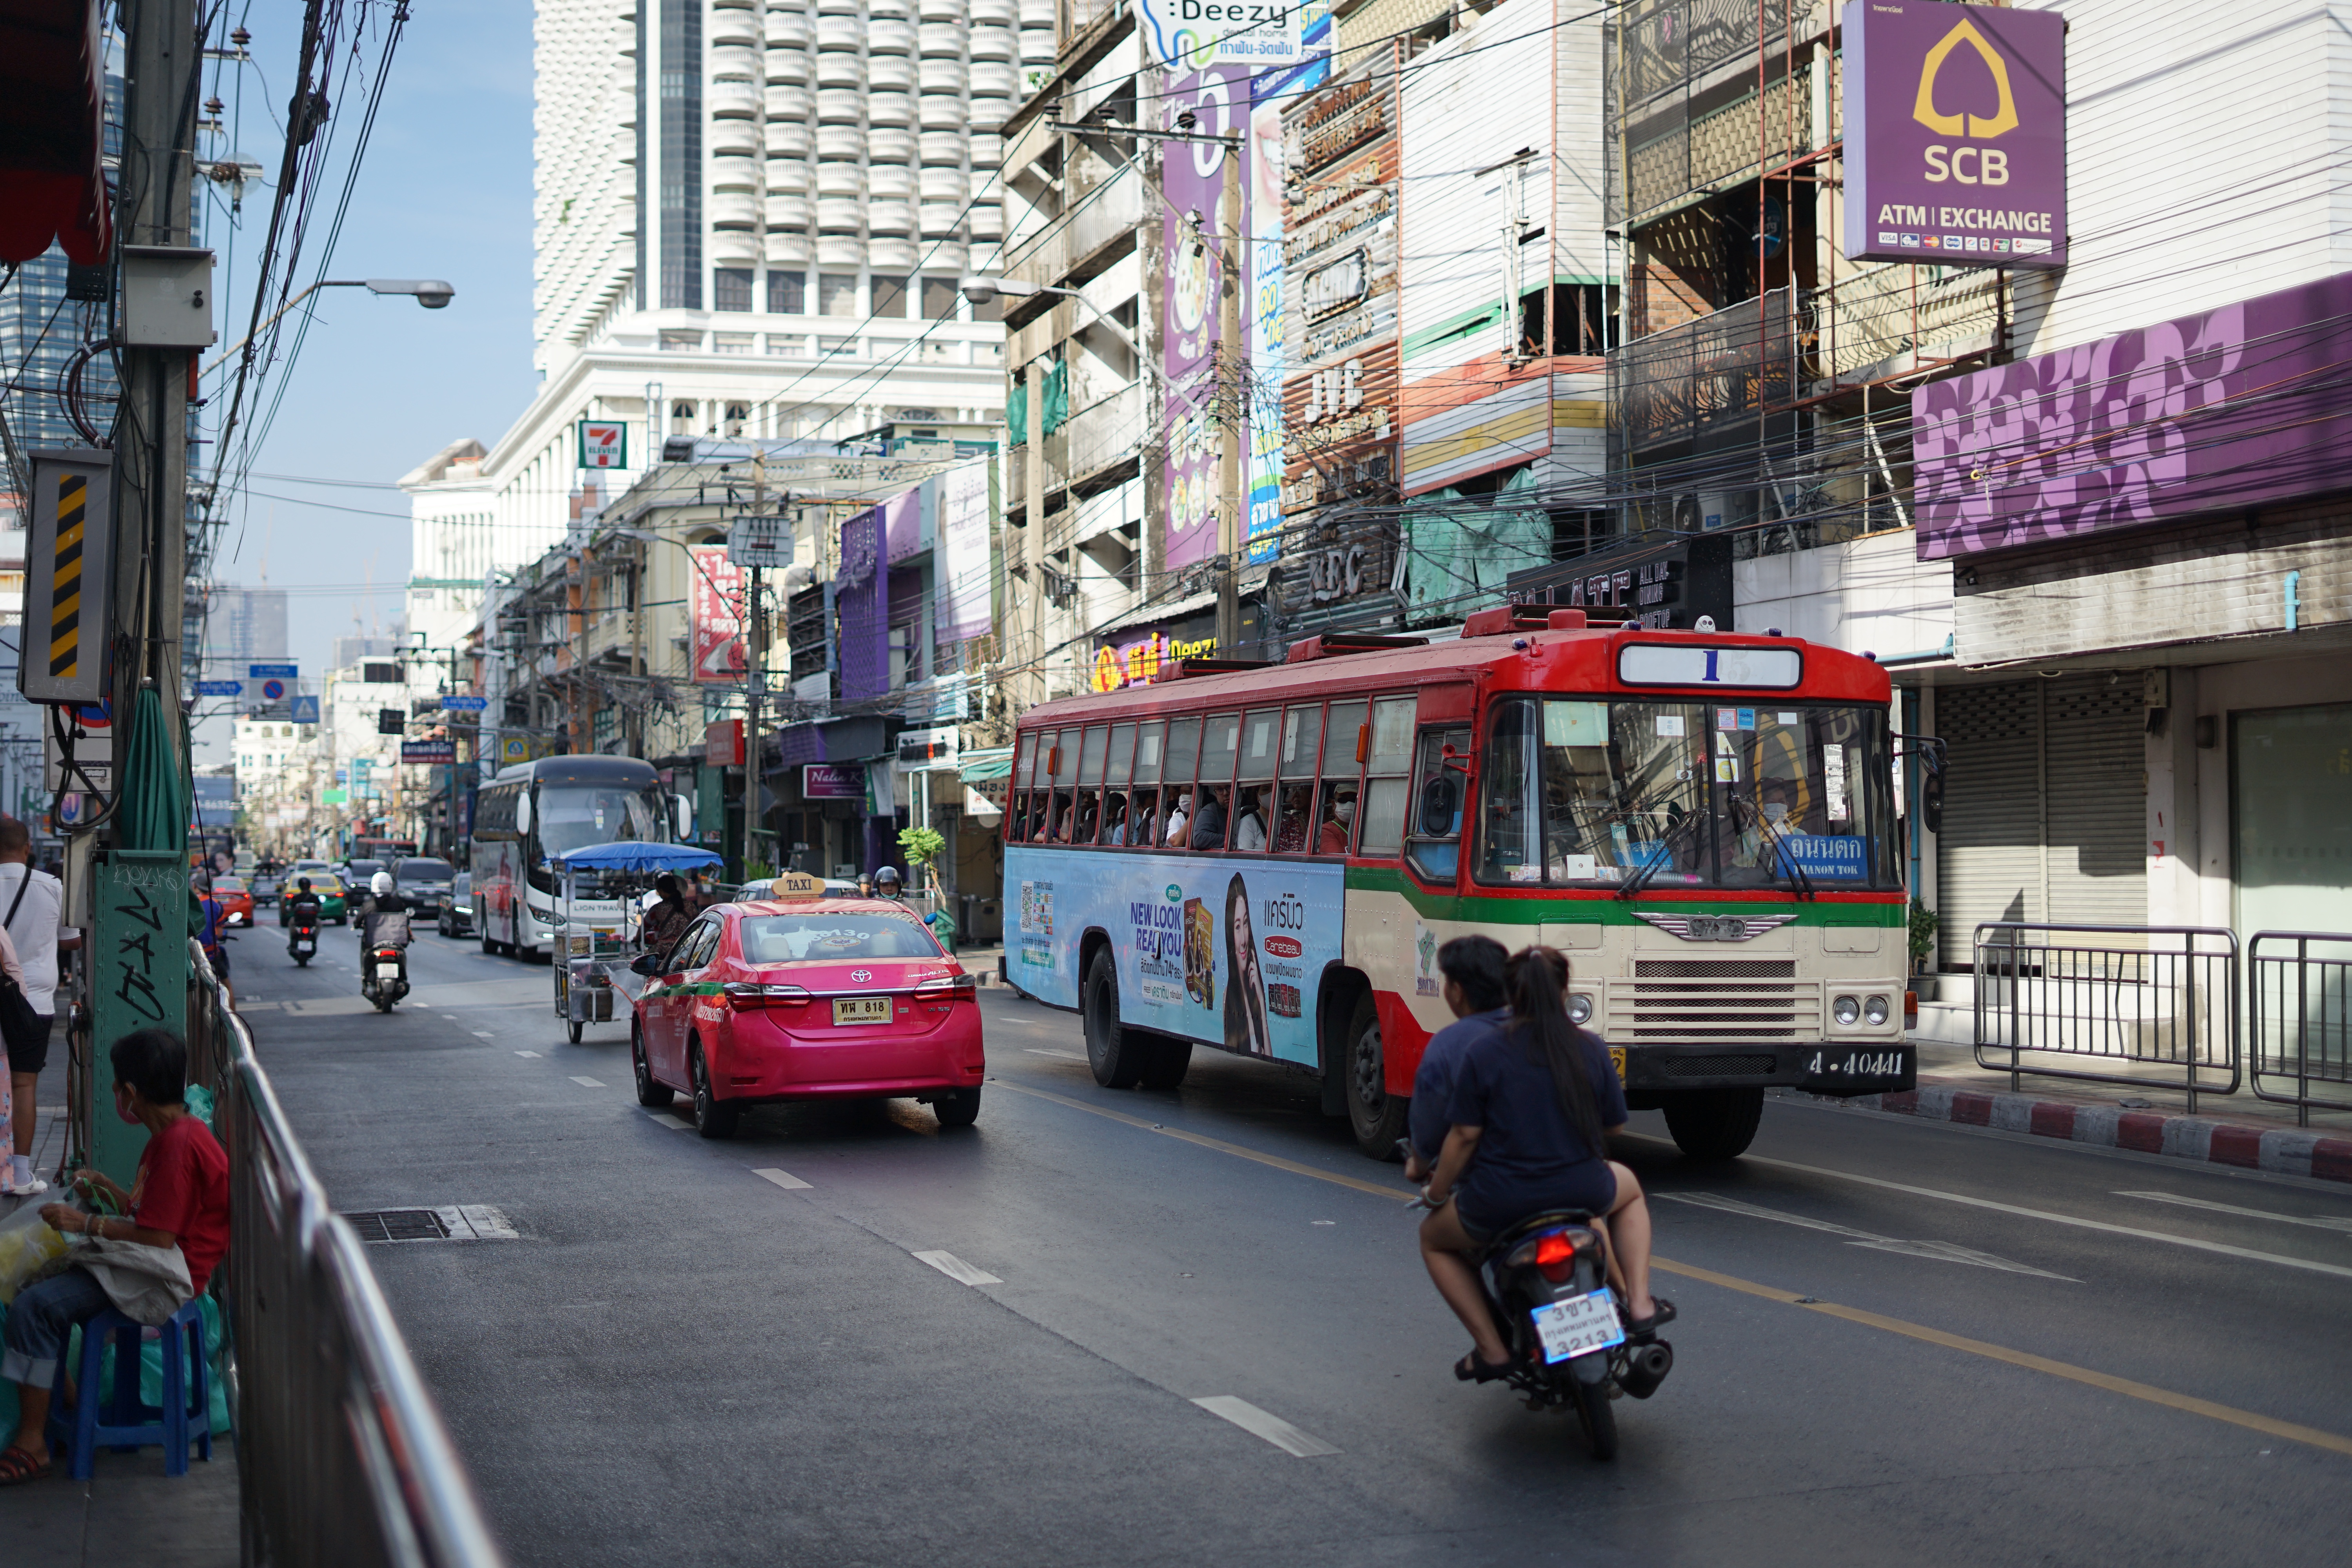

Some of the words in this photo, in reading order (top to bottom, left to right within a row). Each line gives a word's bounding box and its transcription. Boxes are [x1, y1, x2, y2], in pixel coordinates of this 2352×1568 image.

[1223, 28, 1255, 37] dental
[1259, 28, 1288, 38] home
[1924, 145, 2009, 185] SCB
[1878, 204, 1926, 226] ATM
[1940, 207, 2052, 233] EXCHANGE
[1305, 358, 1363, 423] JVC
[1308, 544, 1365, 601] NEC
[1639, 564, 1653, 585] ALL
[1655, 561, 1668, 581] DAY
[1639, 583, 1663, 606] DINING
[1639, 608, 1671, 629] ROOFTOP
[1702, 650, 1720, 681] 1
[1791, 838, 1861, 858] ถนนตก
[1793, 864, 1834, 875] THANON
[1837, 865, 1858, 875] TOK
[786, 878, 812, 891] TAXI
[1131, 902, 1152, 926] NEW
[1154, 904, 1181, 931] LOOK
[1136, 928, 1157, 953] REAL
[1160, 931, 1181, 957] YOU
[1266, 939, 1300, 955] Carebeau
[1265, 963, 1302, 980] แชมพูปิดผมขาว
[865, 1002, 884, 1012] 818
[1545, 1314, 1611, 1339] กรุงเทพมหานคร
[1557, 1329, 1609, 1354] 3213
